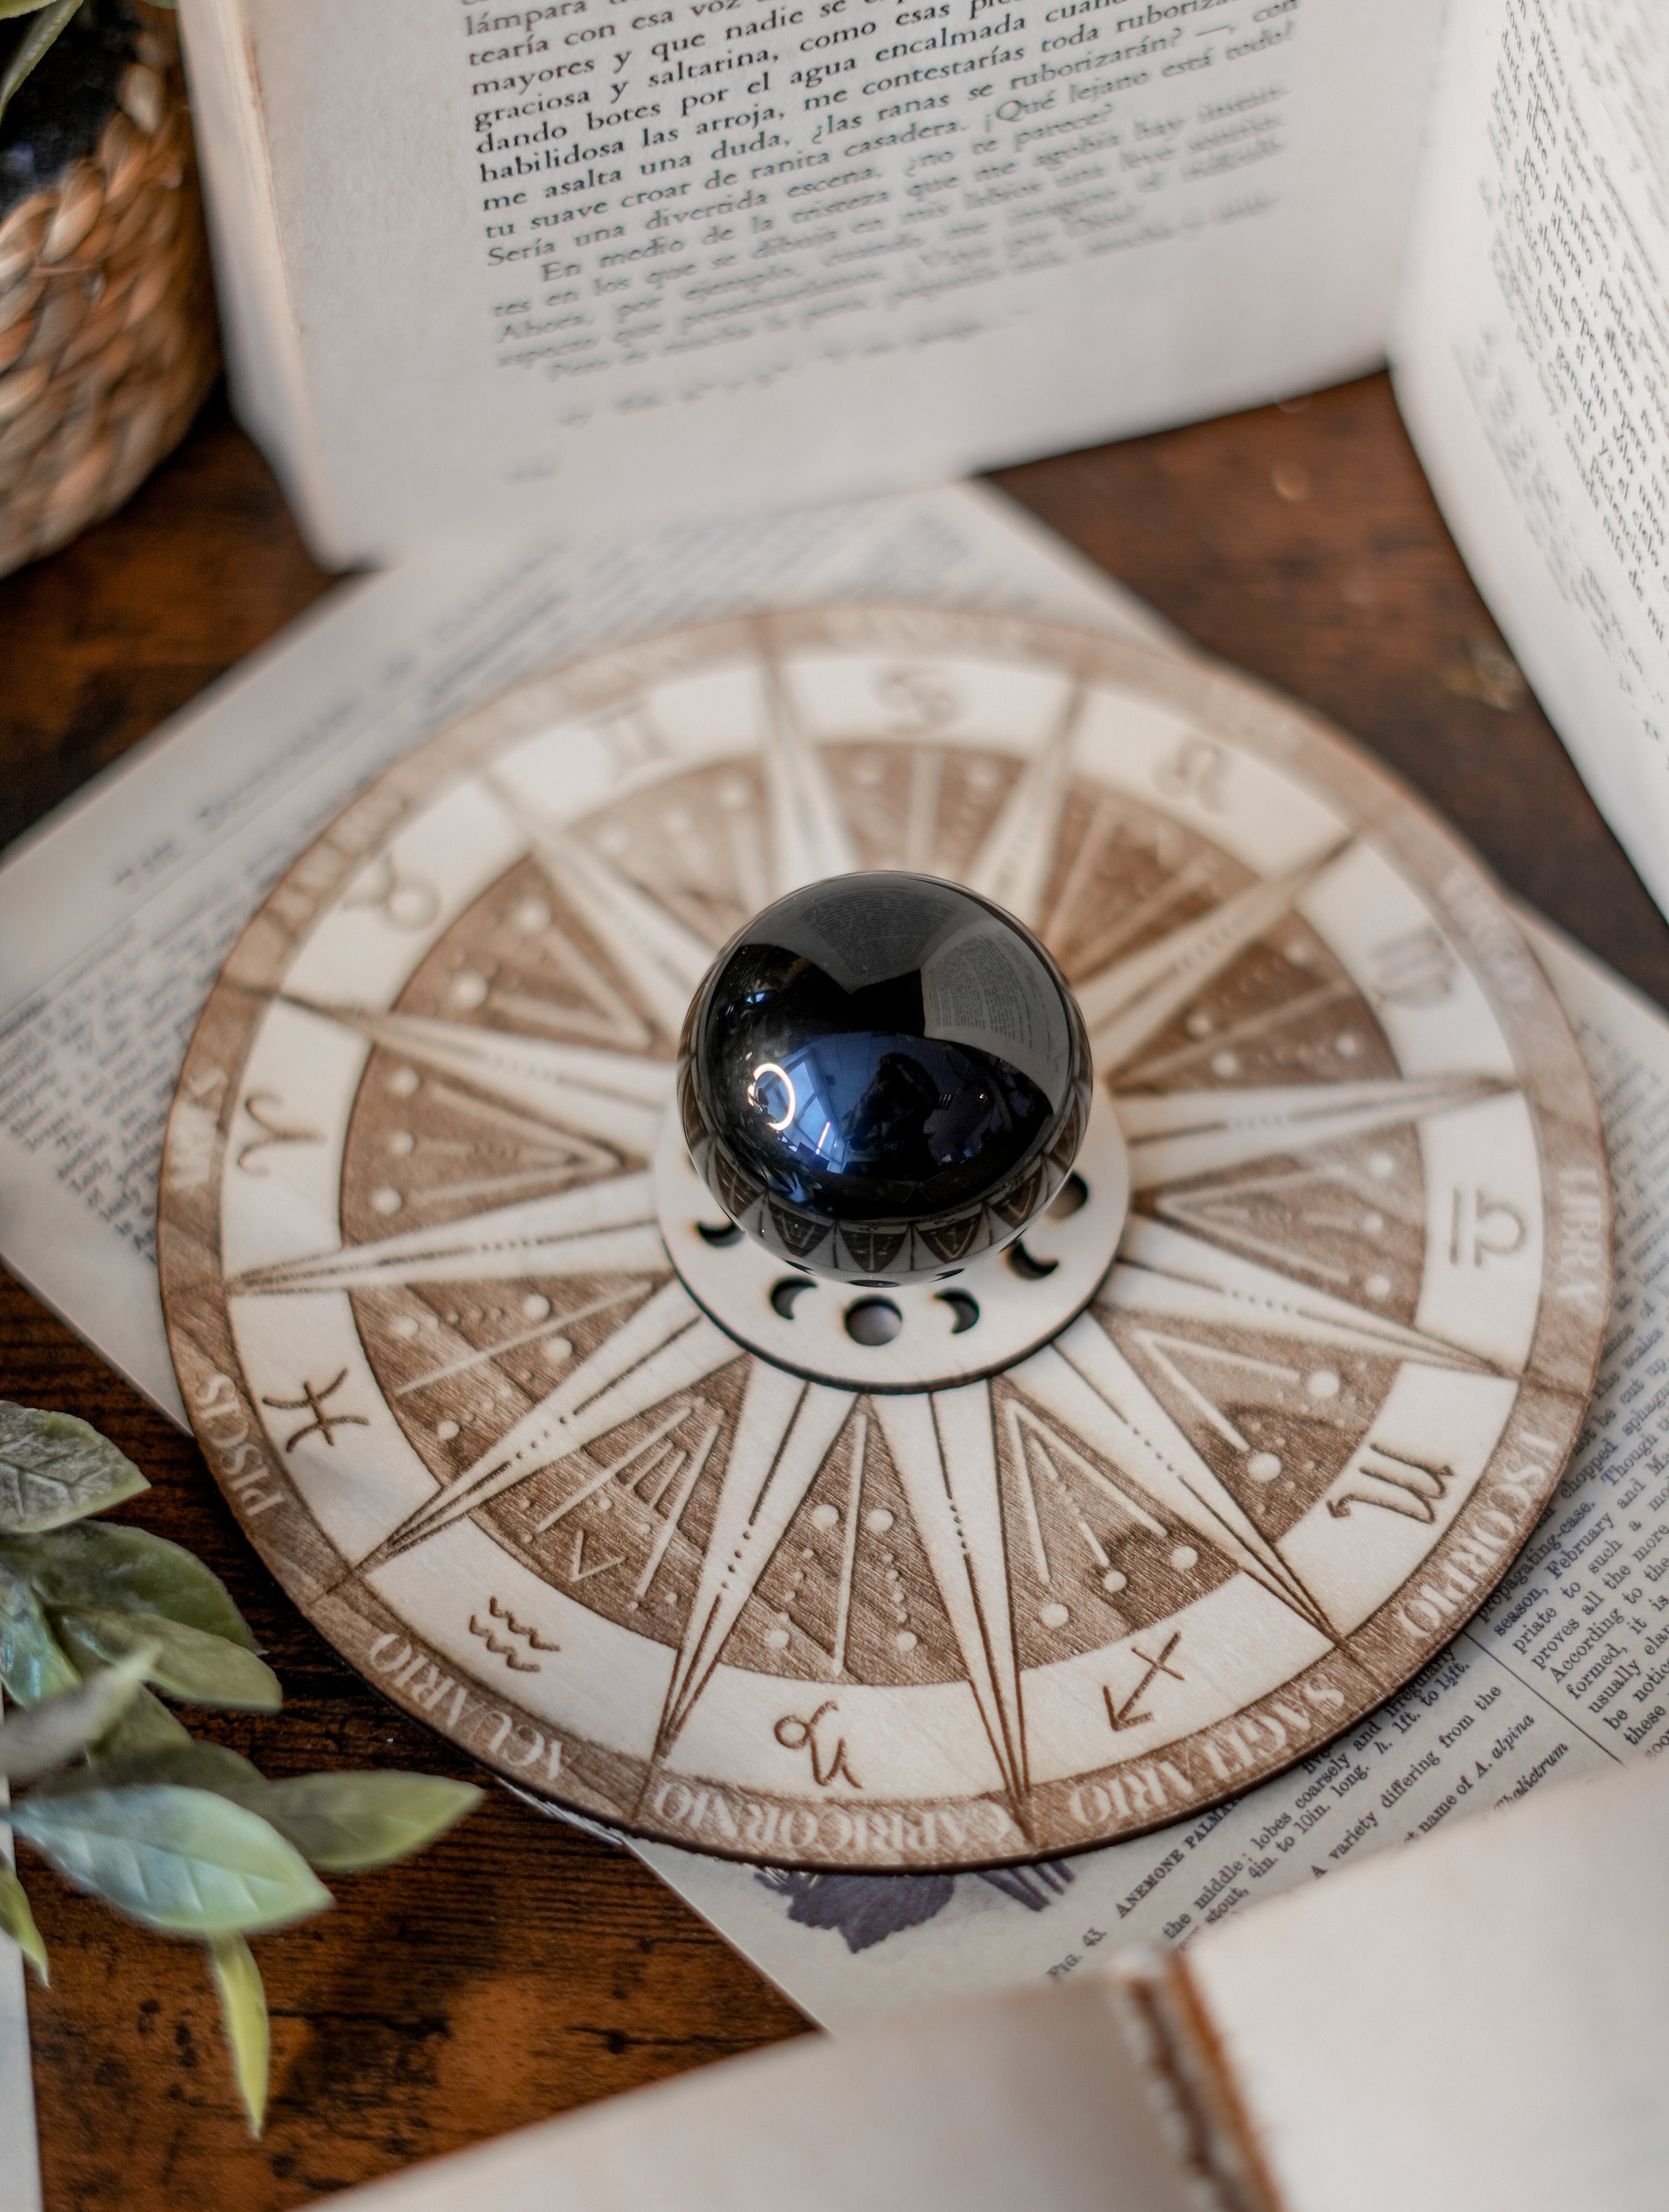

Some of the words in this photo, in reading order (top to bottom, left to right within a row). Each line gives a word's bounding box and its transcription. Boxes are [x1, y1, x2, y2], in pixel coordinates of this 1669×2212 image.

[465, 0, 587, 36] lámpara
[469, 34, 549, 66] tearía
[564, 24, 616, 46] con
[631, 10, 674, 30] esa
[690, 0, 740, 17] voz
[471, 59, 595, 96] mayores
[613, 51, 632, 74] y
[651, 33, 706, 63] que
[726, 6, 804, 41] nadie
[820, 0, 847, 18] se
[474, 90, 591, 134] graciosa
[610, 81, 629, 104] y
[648, 48, 779, 88] saltarina,
[799, 21, 878, 52] como
[895, 4, 950, 26] esas
[475, 121, 568, 154] dando
[586, 103, 661, 131] botes
[681, 88, 729, 118] por
[746, 70, 771, 95] el
[790, 57, 857, 89] agua
[875, 13, 1026, 63] encalmada
[479, 141, 625, 183] habilidosa
[642, 127, 679, 148] las
[696, 107, 784, 135] arroja,
[803, 89, 848, 111] me
[861, 45, 1025, 96] contestarías
[1041, 23, 1100, 53] toda
[484, 192, 527, 211] me
[544, 169, 623, 198] asalta
[639, 154, 692, 175] una
[710, 130, 790, 160] duda,
[811, 114, 862, 144] ¿las
[877, 94, 949, 121] ranas
[968, 83, 993, 101] se
[1010, 27, 1183, 90] ruborizarán?
[485, 224, 515, 238] tu
[530, 202, 607, 230] suave
[621, 183, 692, 208] croar
[704, 169, 737, 189] de
[751, 152, 831, 180] ranita
[843, 121, 967, 157] casadera.
[488, 238, 556, 266] Sería
[574, 225, 626, 246] una
[644, 190, 768, 230] divertida
[539, 261, 582, 282] En
[599, 237, 685, 268] medio
[702, 225, 734, 245] de
[195, 1373, 285, 1517] PISCIS
[1600, 1432, 1658, 1486] Though
[1493, 1588, 1549, 1637] season,
[1545, 1512, 1615, 1579] February
[1617, 1480, 1646, 1509] and
[1511, 1607, 1557, 1655] priate
[1561, 1582, 1581, 1599] to
[1587, 1540, 1623, 1575] such
[1628, 1521, 1642, 1532] a
[1530, 1618, 1580, 1671] proves
[1581, 1590, 1605, 1616] all
[1602, 1565, 1631, 1590] the
[1631, 1525, 1669, 1562] more
[1549, 1608, 1624, 1684] According
[1622, 1588, 1644, 1605] to
[1643, 1558, 1669, 1582] the
[1566, 1643, 1628, 1700] formed,
[1626, 1617, 1648, 1635] it
[369, 1633, 580, 1780] ACUARIO
[1587, 1659, 1642, 1713] usually
[1602, 1709, 1628, 1730] be
[1623, 1705, 1667, 1746] these
[1071, 1675, 1346, 1826] SAGITARIO
[1205, 1887, 1249, 1924] stout,
[1248, 1856, 1279, 1879] 4in.
[1276, 1835, 1295, 1853] to
[1293, 1803, 1331, 1834] 10in.
[1331, 1764, 1370, 1798] long.
[1374, 1741, 1393, 1755] h.
[1392, 1711, 1421, 1735] 1ft.
[1420, 1690, 1439, 1707] to
[1311, 1864, 1328, 1879] A
[1328, 1811, 1378, 1860] variety
[1380, 1751, 1440, 1808] differing
[1438, 1714, 1475, 1749] from
[1474, 1686, 1501, 1711] the
[1417, 1791, 1457, 1835] name
[1454, 1775, 1474, 1796] of
[1473, 1759, 1493, 1779] A.
[1492, 1713, 1535, 1761] alpina
[653, 1781, 1013, 1851] CAPRICORNIO
[1163, 1912, 1191, 1939] the
[1250, 1812, 1292, 1850] lobes
[1295, 1754, 1350, 1809] coarsely
[1353, 1720, 1382, 1751] and
[1082, 1927, 1107, 1947] 43.
[1115, 1849, 1185, 1918] ANEMONE
